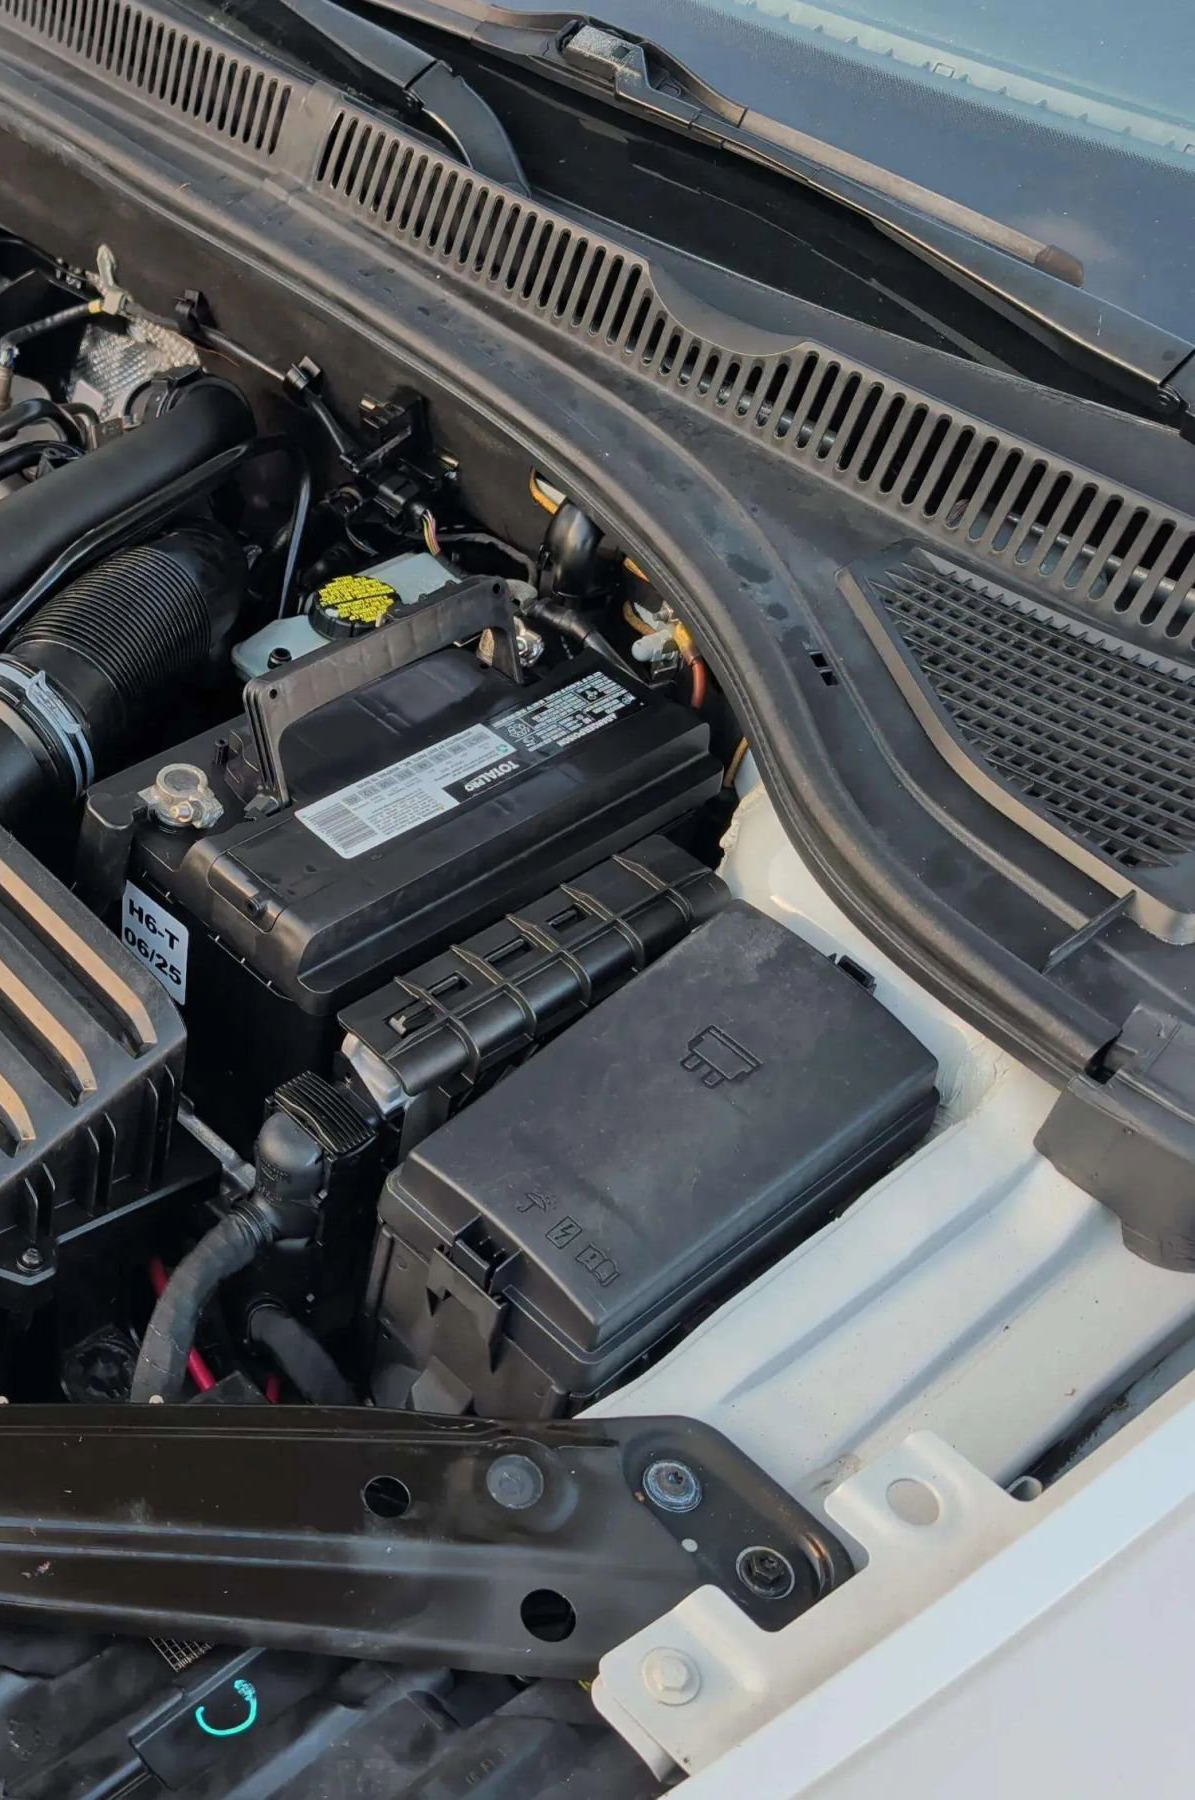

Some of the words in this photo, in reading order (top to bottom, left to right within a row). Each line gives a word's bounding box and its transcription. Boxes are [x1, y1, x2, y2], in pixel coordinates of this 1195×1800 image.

[461, 756, 520, 793] TOTALPRO
[129, 898, 179, 949] H6-T
[124, 927, 181, 984] 06/25
